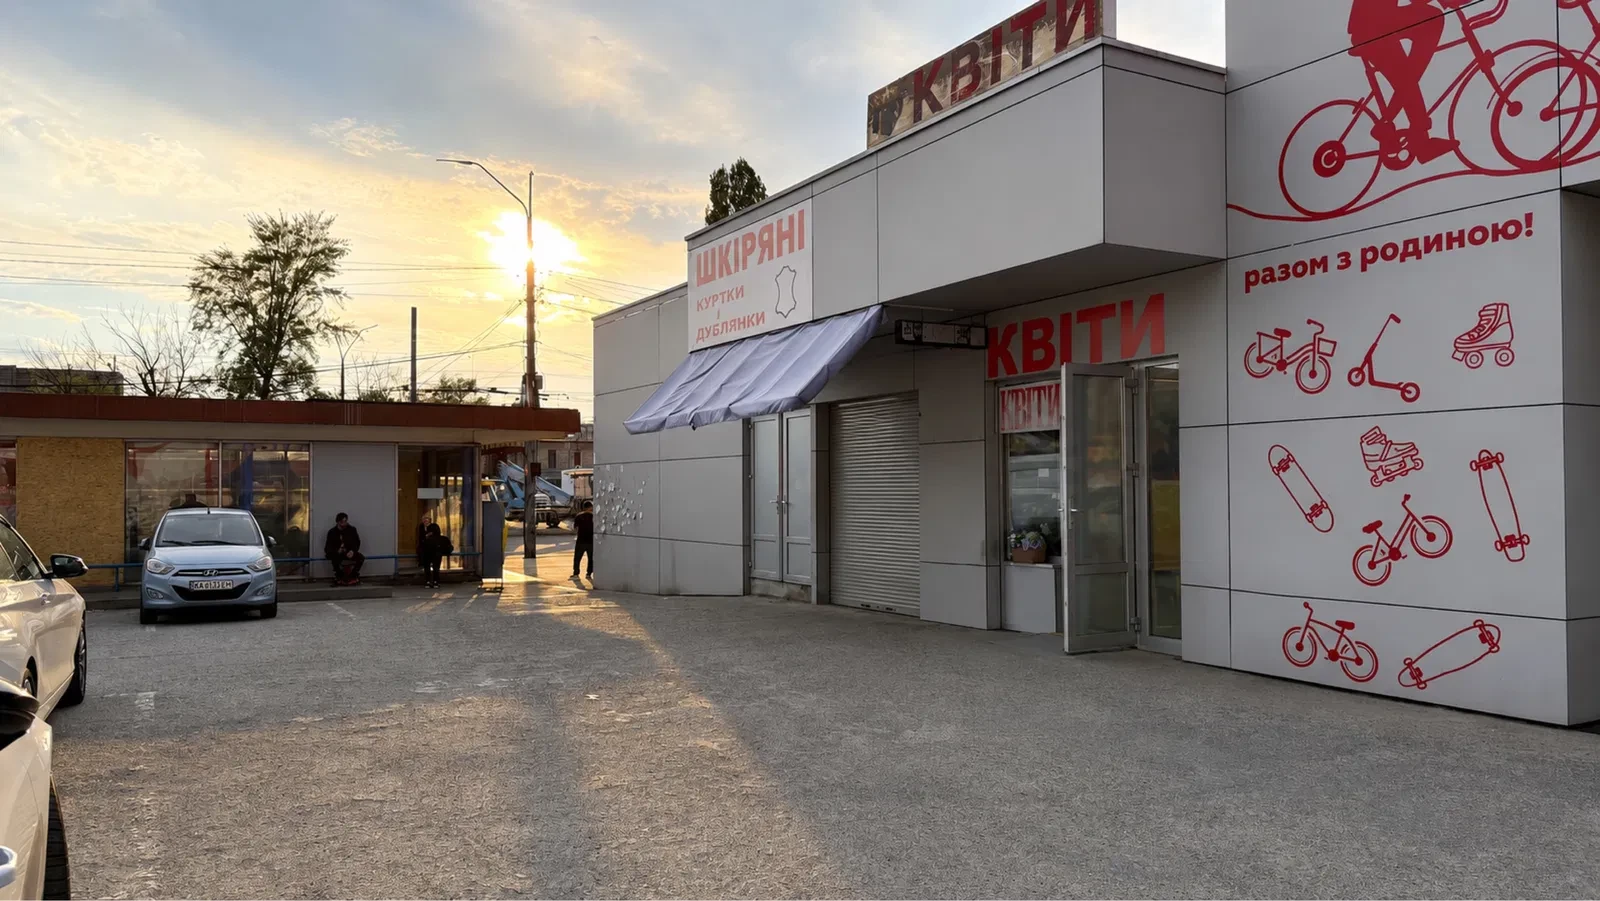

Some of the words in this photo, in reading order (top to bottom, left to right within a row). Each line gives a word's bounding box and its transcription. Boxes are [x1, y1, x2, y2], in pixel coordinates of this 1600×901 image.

[913, 0, 1095, 124] КВІТИ
[696, 208, 805, 287] ШКІРЯНІ
[1244, 255, 1328, 293] разом
[1336, 251, 1352, 270] з
[1360, 212, 1534, 272] родиною!
[695, 311, 766, 344] ДУБЛЯНКИ
[696, 285, 745, 312] КУРТКИ
[987, 293, 1165, 378] КВІТИ
[1000, 384, 1062, 431] КВІТИ
